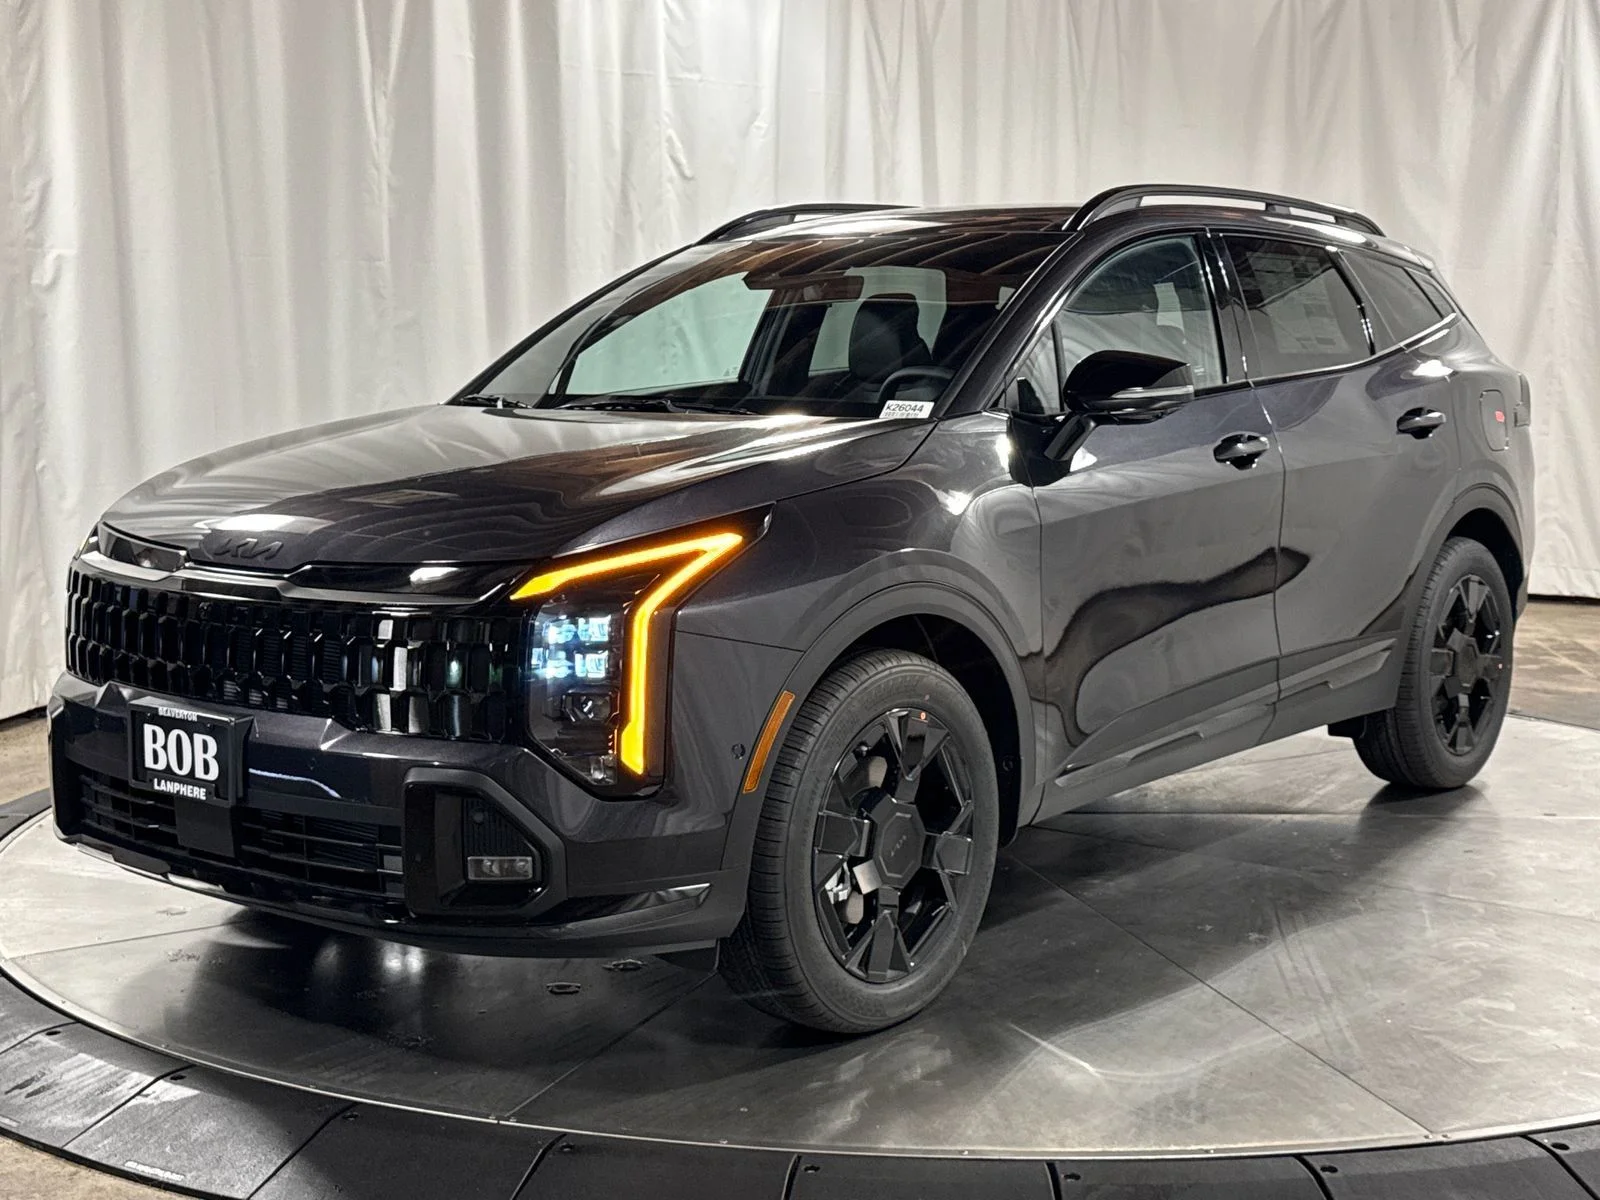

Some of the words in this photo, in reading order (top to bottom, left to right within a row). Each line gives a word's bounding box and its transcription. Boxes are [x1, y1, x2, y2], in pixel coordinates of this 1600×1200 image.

[886, 403, 924, 412] K26044
[158, 706, 198, 722] BEAVERTON
[143, 723, 219, 781] BOB
[153, 778, 207, 801] LANPHERE
